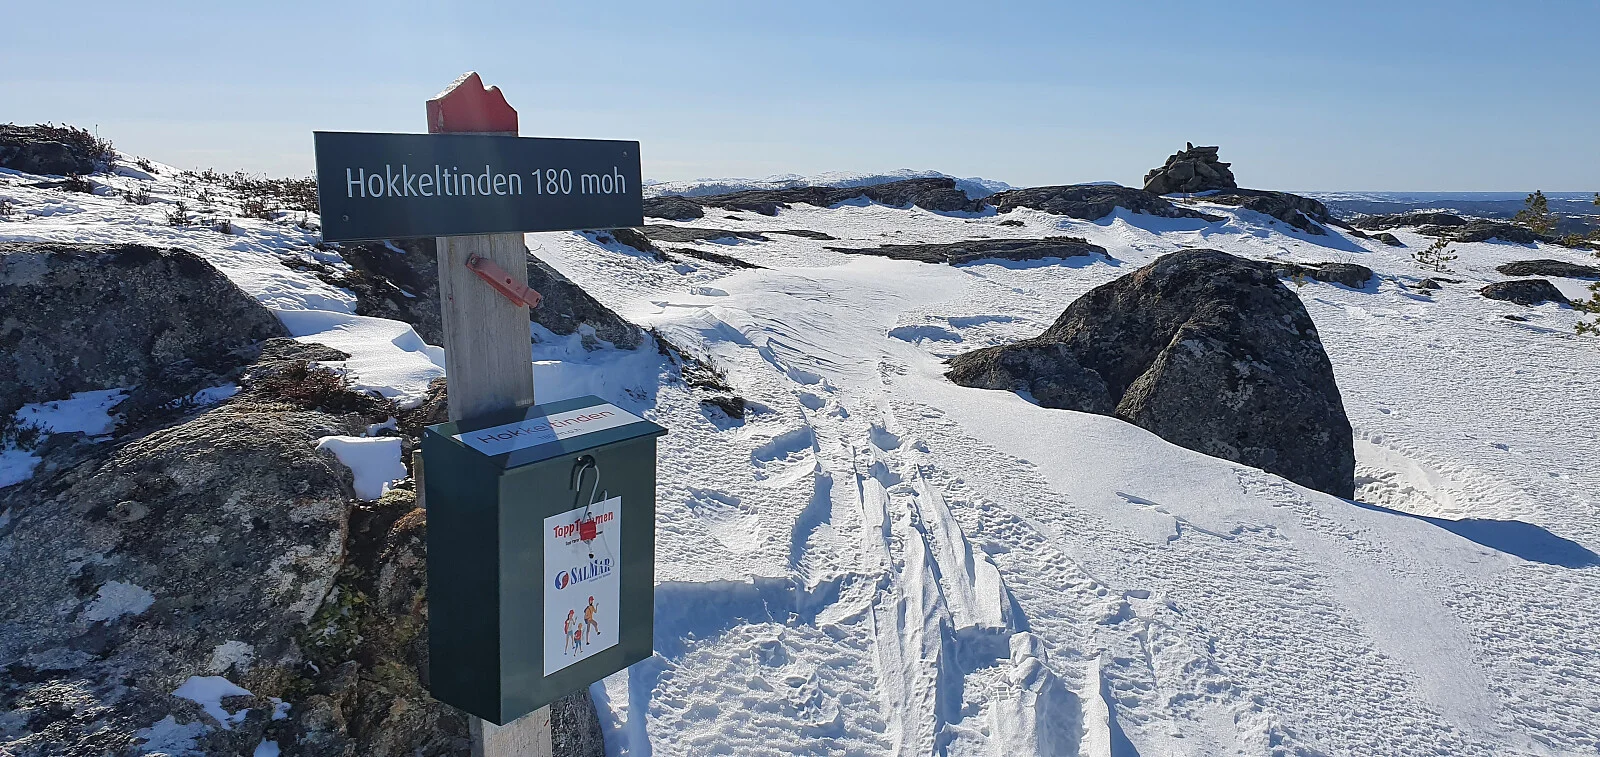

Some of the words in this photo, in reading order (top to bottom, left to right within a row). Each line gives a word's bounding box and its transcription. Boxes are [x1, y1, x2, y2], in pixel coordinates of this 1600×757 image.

[346, 165, 522, 198] Hokkeltinden
[531, 168, 572, 195] 180
[581, 166, 626, 194] moh
[477, 410, 615, 443] Hokkeltinden
